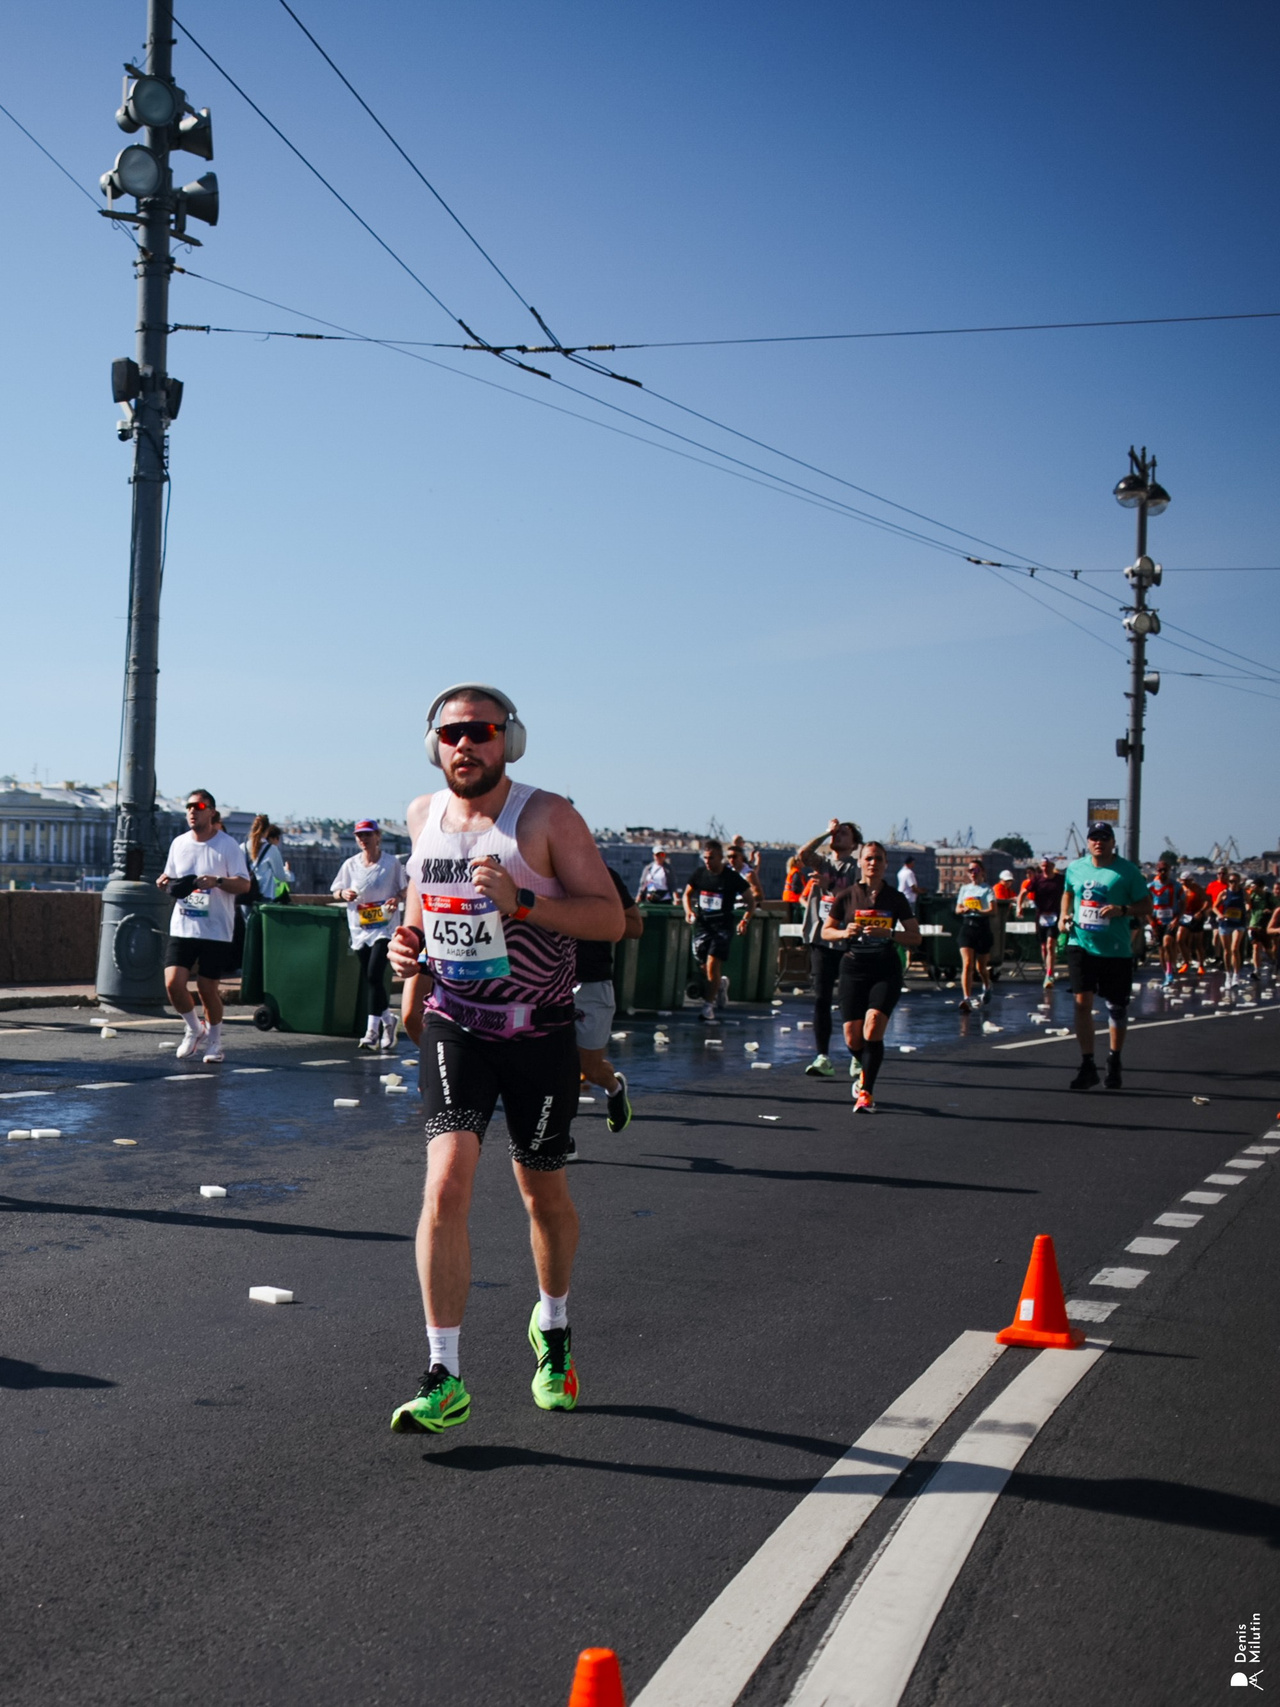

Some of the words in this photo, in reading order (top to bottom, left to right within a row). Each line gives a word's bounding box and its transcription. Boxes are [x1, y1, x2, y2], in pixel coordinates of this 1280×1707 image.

[421, 858, 433, 884] IN
[431, 858, 455, 884] RUN
[432, 920, 492, 947] 4534
[446, 948, 478, 958] АНДРЕЙ
[433, 959, 444, 975] E
[437, 1041, 446, 1066] TRUST
